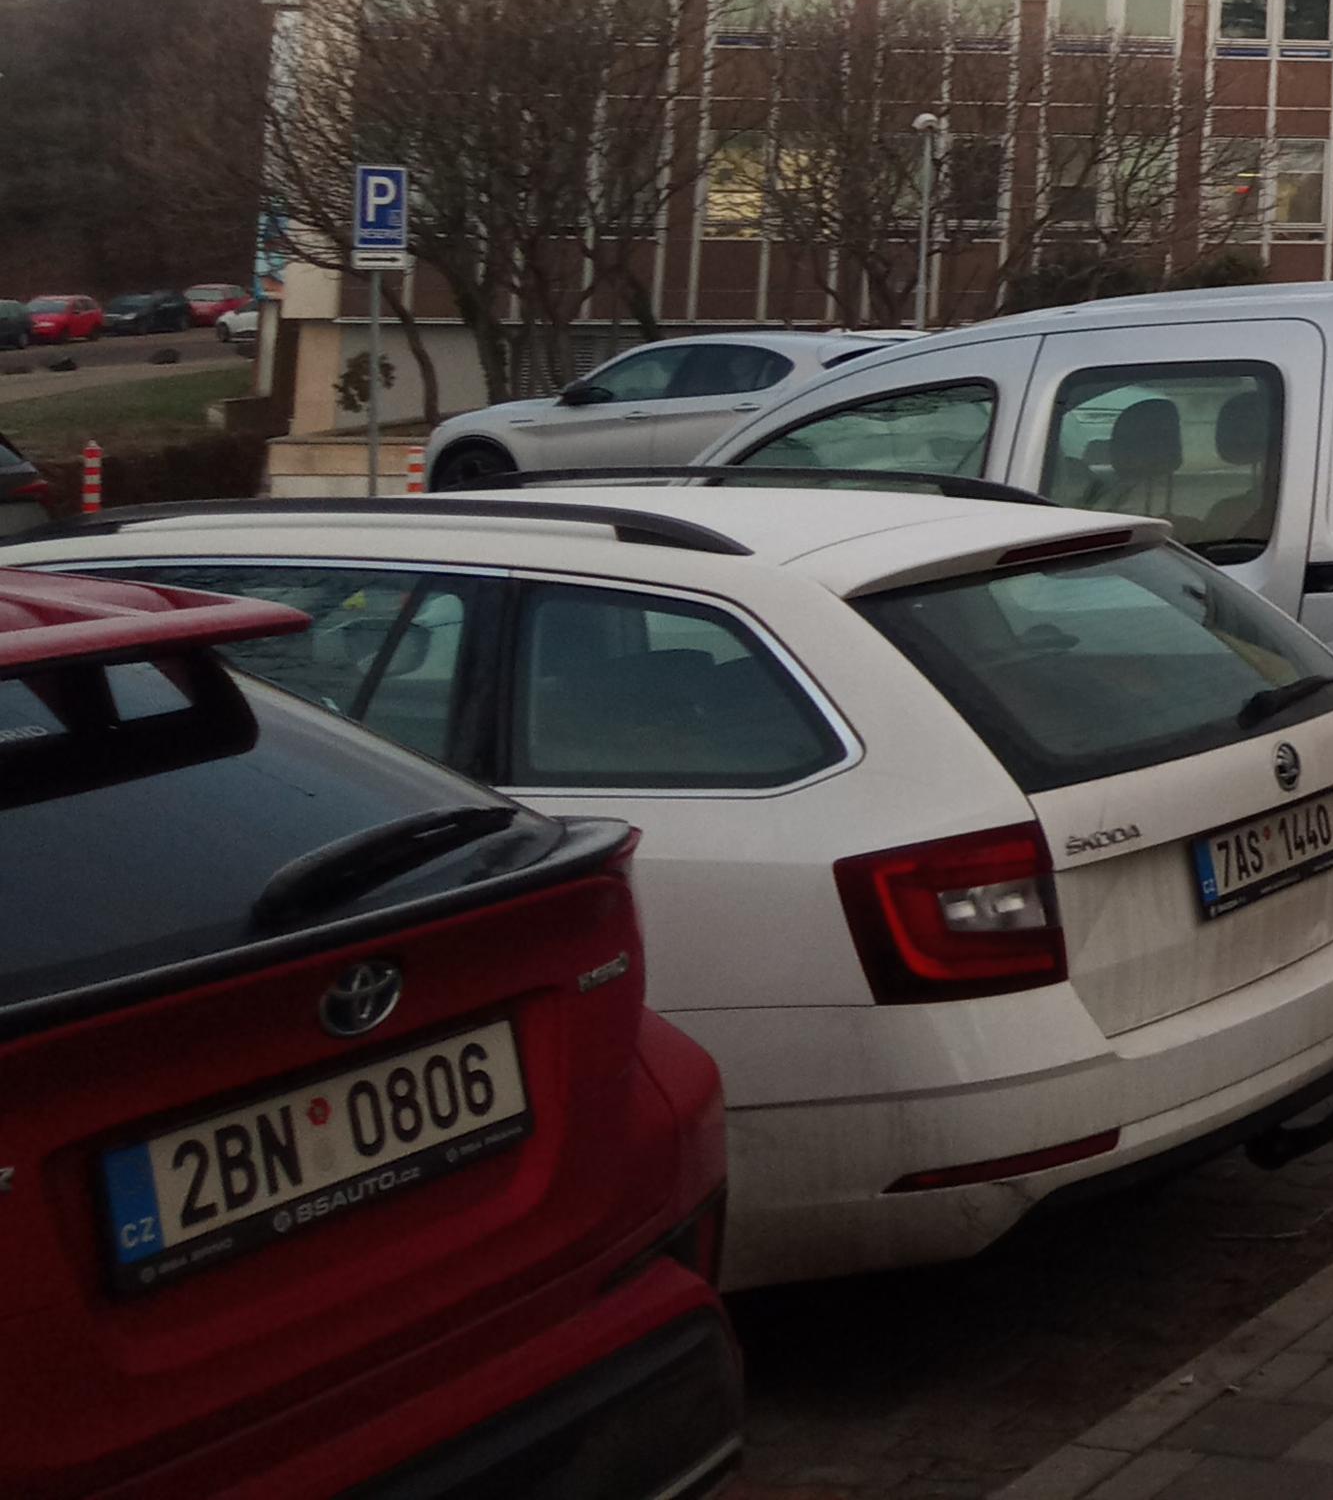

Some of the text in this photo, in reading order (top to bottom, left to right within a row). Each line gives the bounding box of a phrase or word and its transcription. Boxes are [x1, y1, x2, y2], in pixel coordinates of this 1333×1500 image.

[366, 175, 397, 223] P
[1065, 824, 1143, 856] ŠKODA
[1216, 804, 1333, 888] 7AS 1440
[171, 1043, 496, 1231] 2BN 0806
[120, 1217, 157, 1249] CZ
